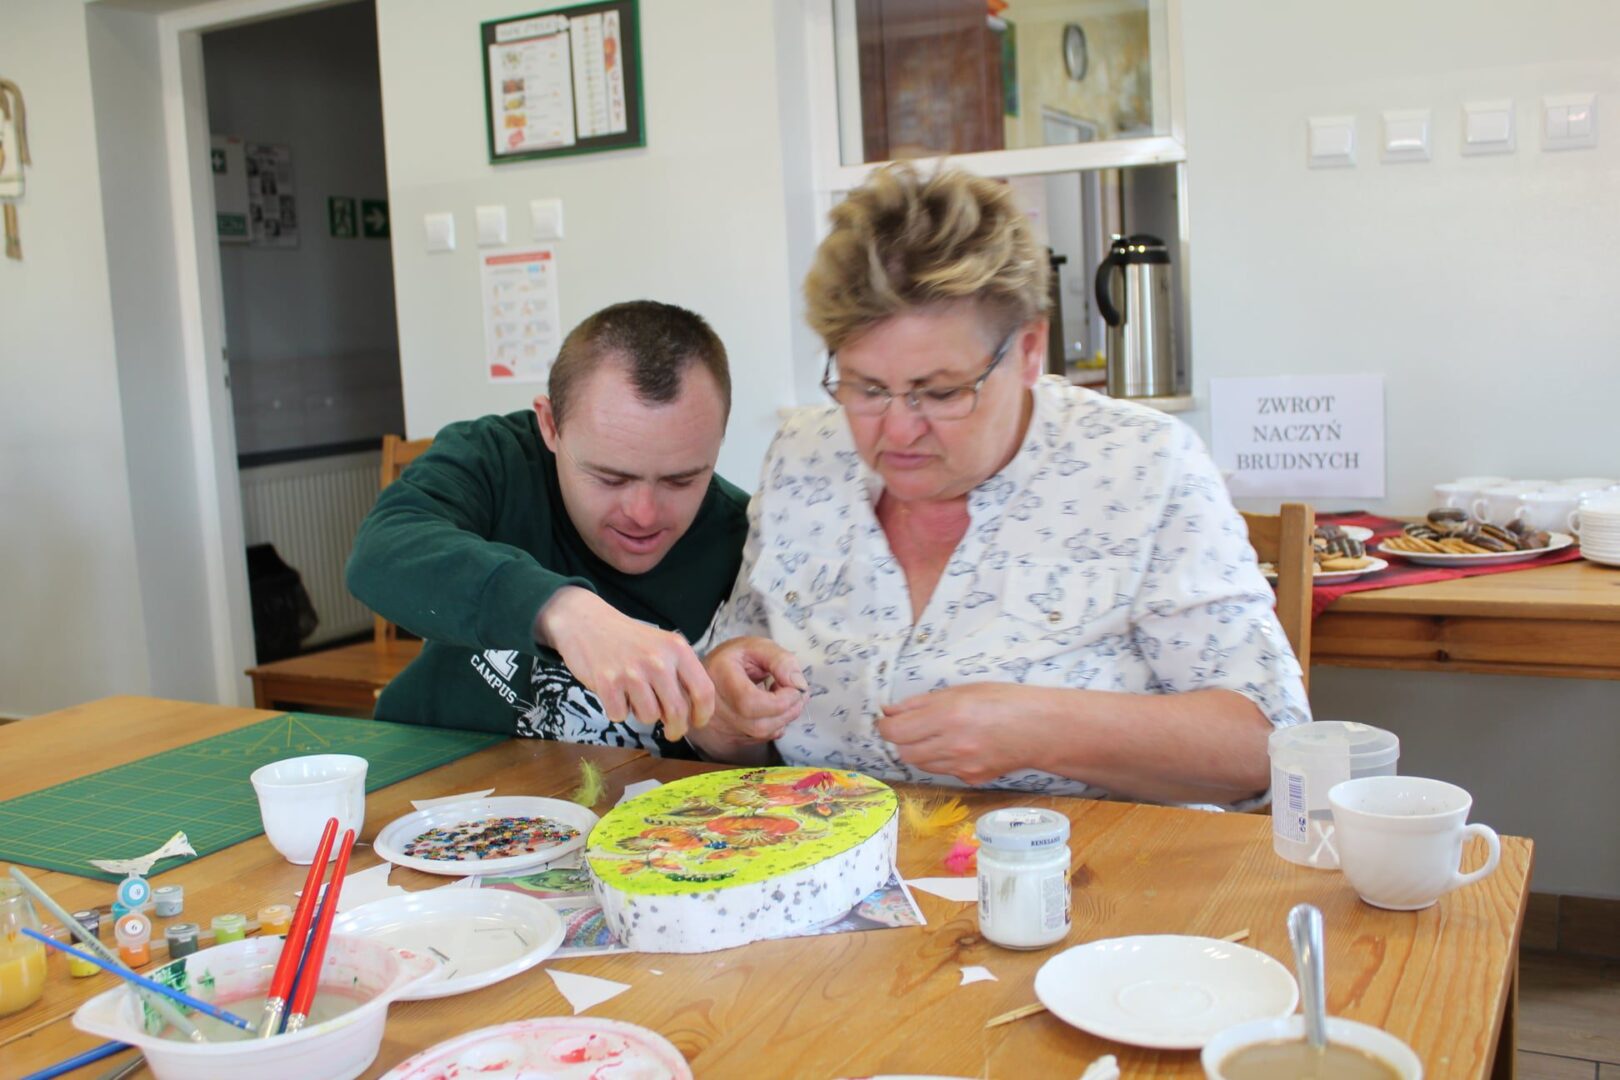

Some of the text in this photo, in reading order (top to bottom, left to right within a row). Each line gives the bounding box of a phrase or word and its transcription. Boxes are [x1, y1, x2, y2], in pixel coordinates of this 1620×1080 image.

[1257, 395, 1335, 415] ZWROT
[1252, 419, 1342, 442] NACZYŃ
[1236, 452, 1359, 470] BRUDNYCH
[470, 654, 517, 704] CAMPUS
